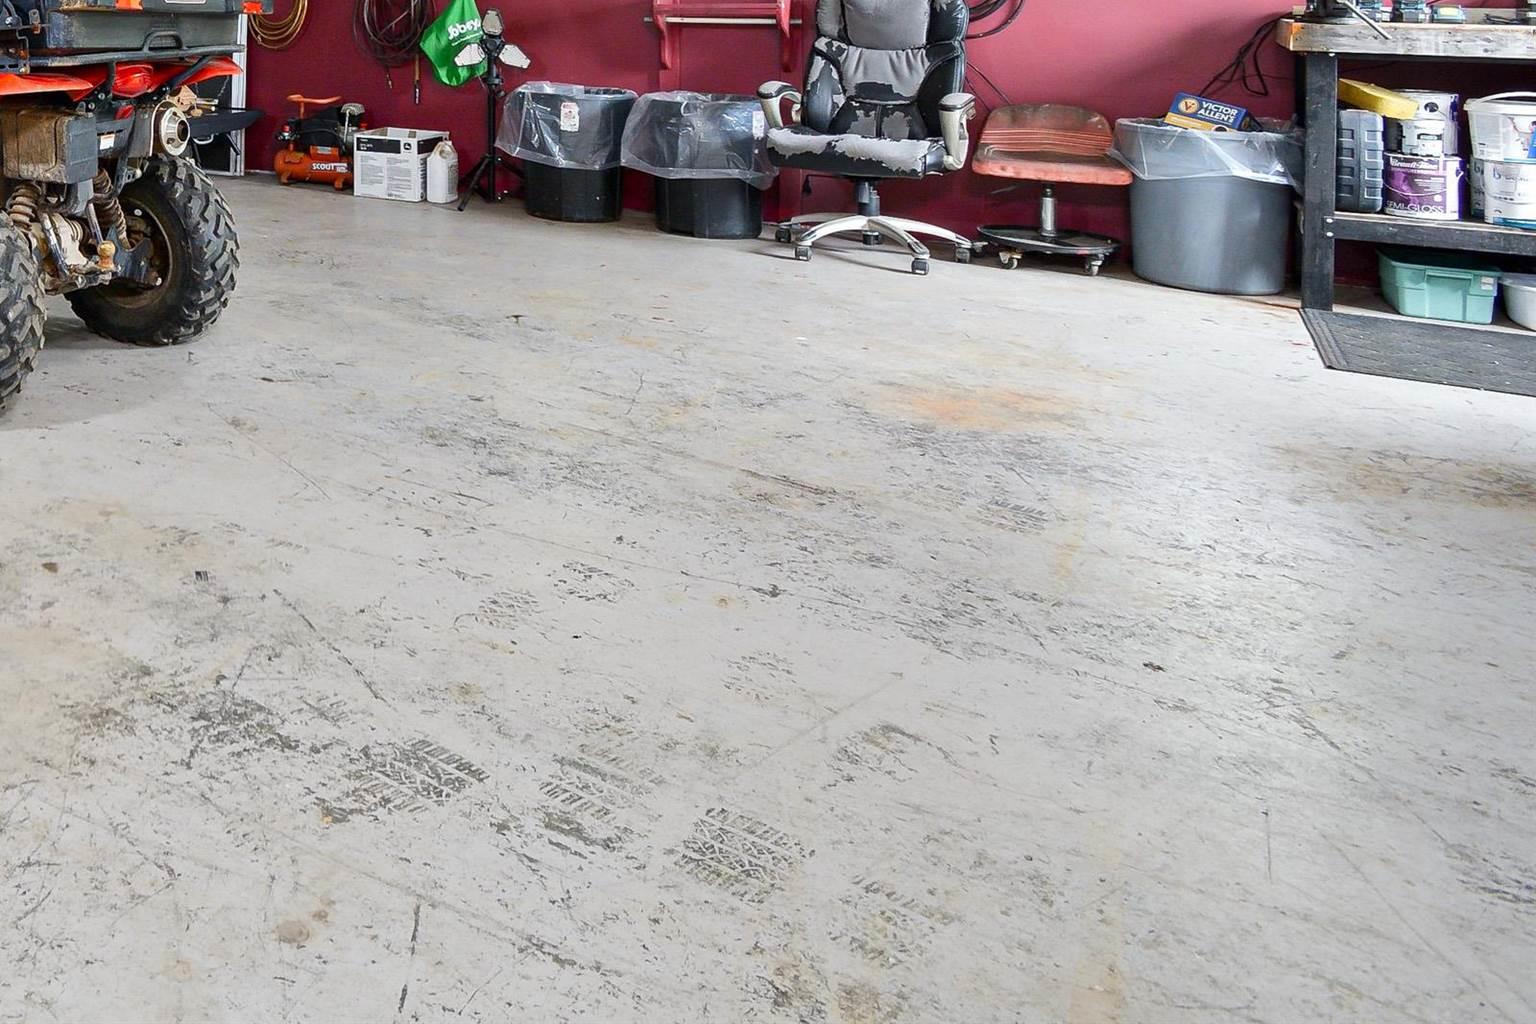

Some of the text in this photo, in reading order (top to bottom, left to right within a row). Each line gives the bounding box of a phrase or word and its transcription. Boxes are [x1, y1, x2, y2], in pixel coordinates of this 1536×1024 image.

[1202, 101, 1239, 116] VICTOR
[312, 162, 339, 171] SCOUT
[1386, 200, 1445, 214] SEMI-GLOSS
